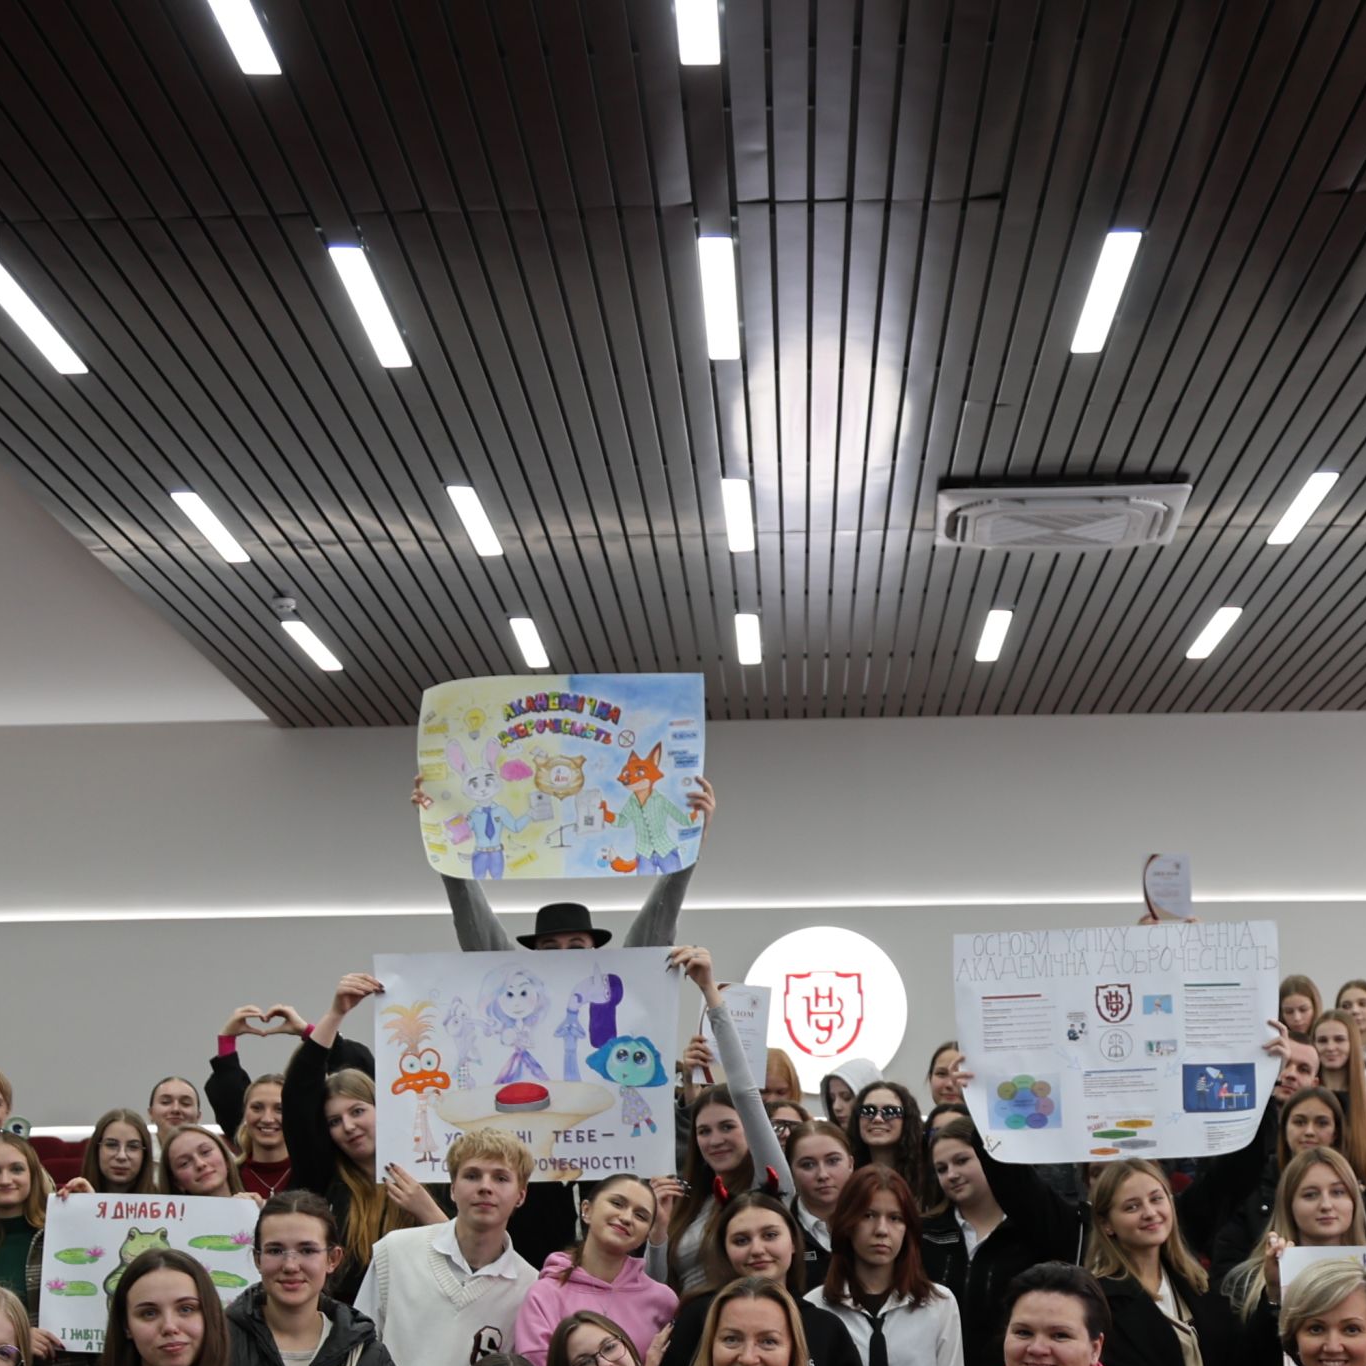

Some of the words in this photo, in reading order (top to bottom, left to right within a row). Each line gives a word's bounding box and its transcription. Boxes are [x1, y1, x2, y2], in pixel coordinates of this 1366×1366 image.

[501, 691, 622, 725] АКАДЕМІЧНА
[972, 932, 1051, 957] ОСНОВИ
[1065, 926, 1131, 953] УСПІХУ
[1146, 921, 1257, 948] СТУДЕНТА
[955, 951, 1091, 983] АКАДЕМІЧНА
[1097, 944, 1280, 975] ДОБРОЧЕСНІСТЬ
[96, 1201, 108, 1219] Я
